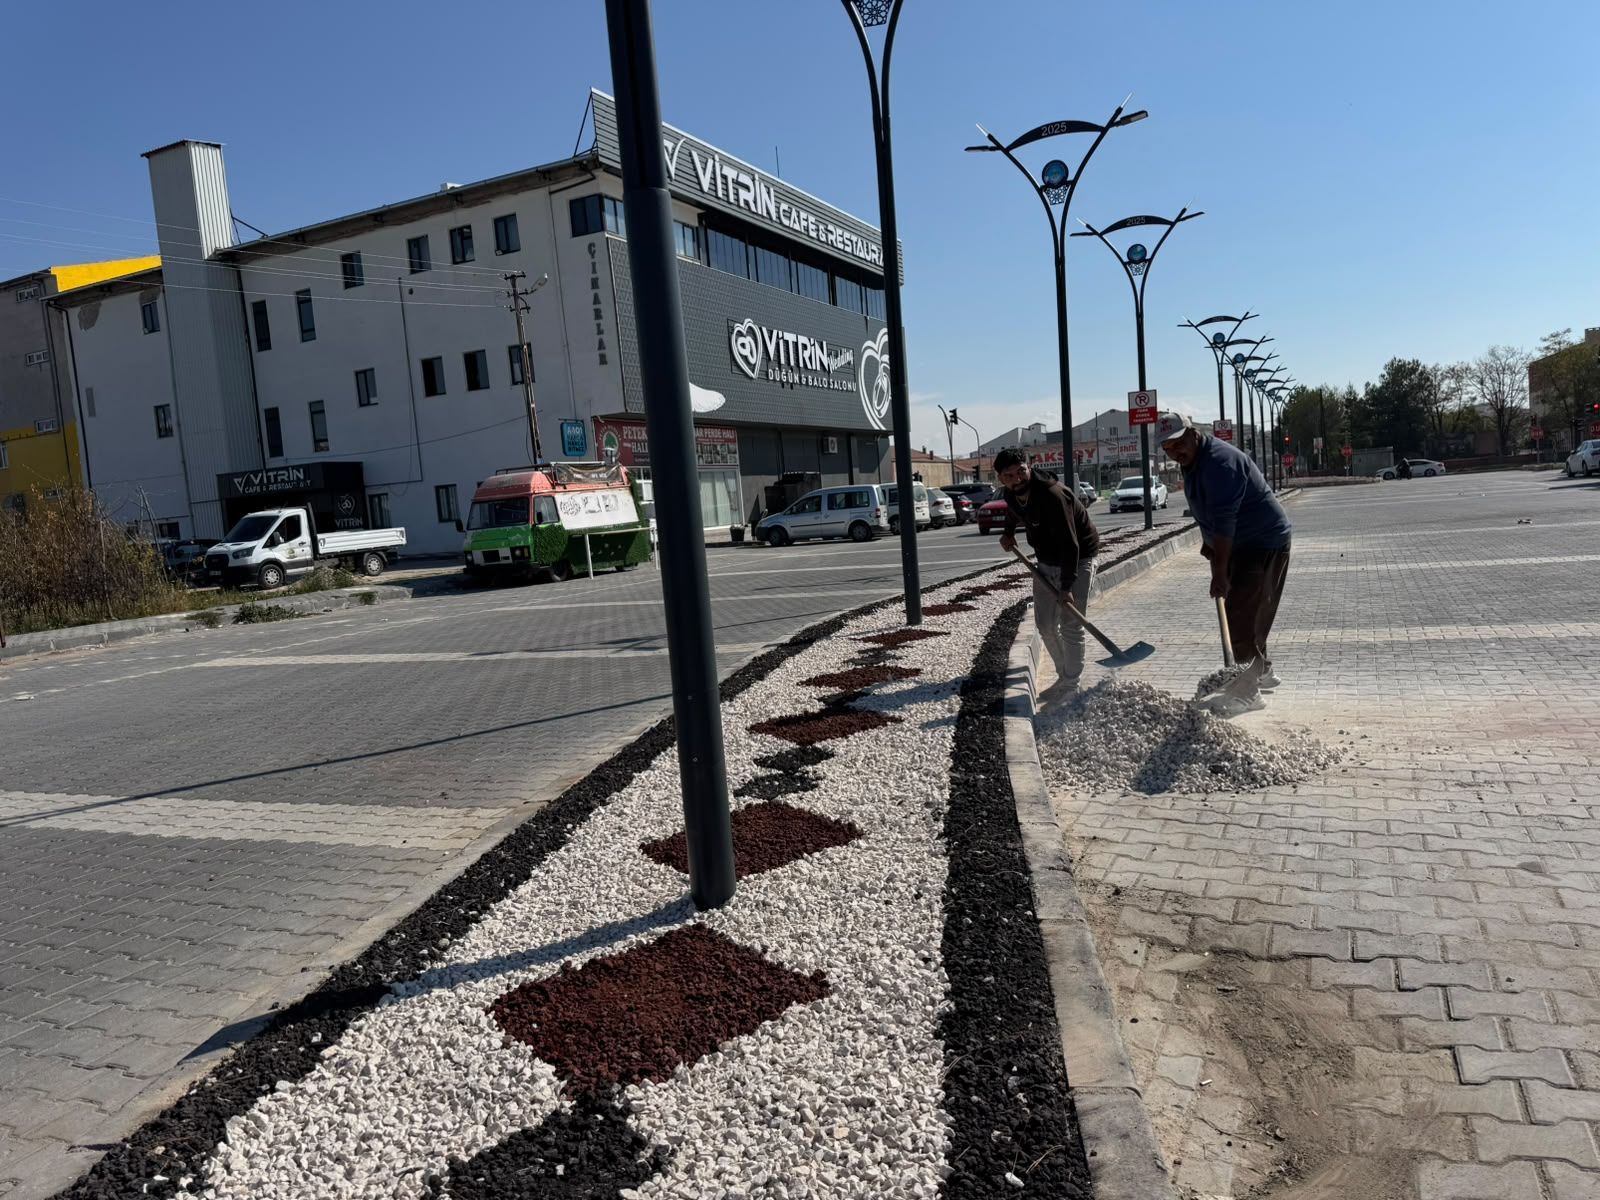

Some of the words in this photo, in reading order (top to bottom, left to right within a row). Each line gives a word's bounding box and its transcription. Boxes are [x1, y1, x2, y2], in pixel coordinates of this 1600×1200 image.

[1041, 122, 1067, 137] 2025
[691, 149, 776, 221] VİTRİN
[779, 201, 819, 239] CAFE
[761, 325, 830, 373] VİTRİN
[768, 367, 800, 384] DÜĞÜN
[808, 375, 829, 389] BALO
[829, 378, 857, 392] SALONU
[249, 466, 305, 485] VİTRİN
